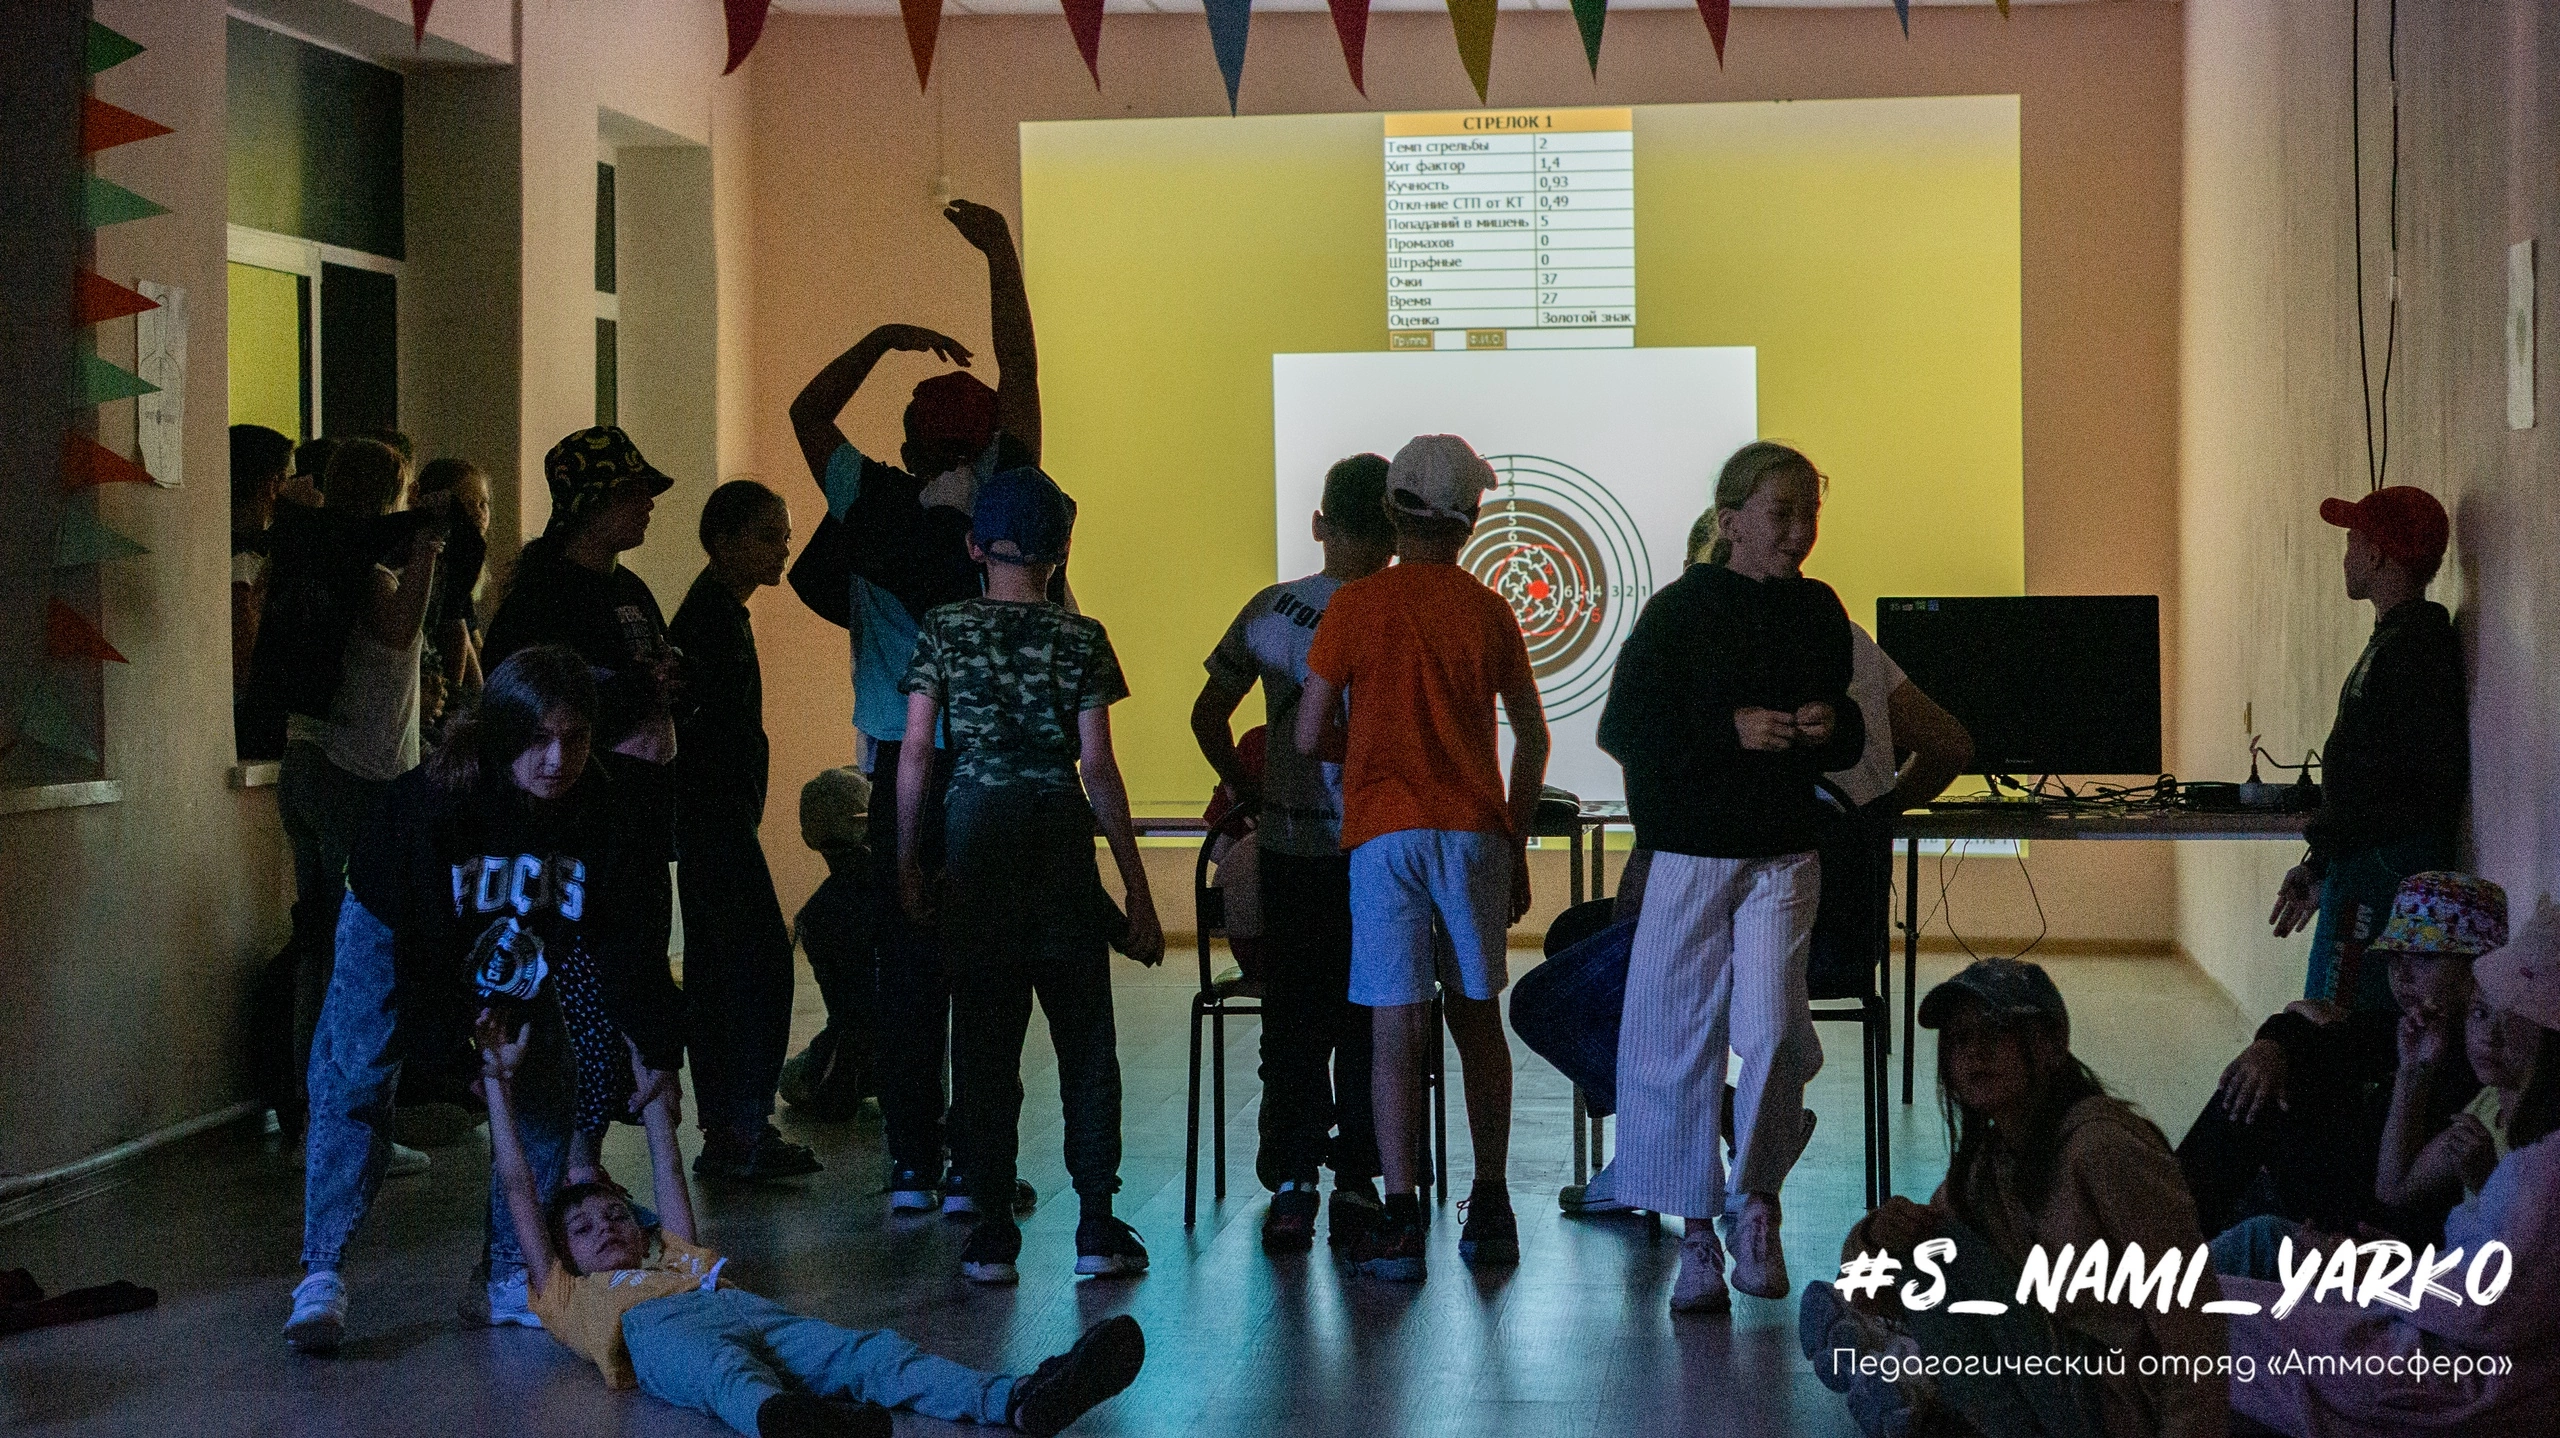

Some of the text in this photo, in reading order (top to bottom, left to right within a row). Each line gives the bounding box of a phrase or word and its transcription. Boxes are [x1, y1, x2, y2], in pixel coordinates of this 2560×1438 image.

[1463, 115, 1553, 130] СТРЕЛОК 1
[1388, 140, 1489, 155] Темп стрельбы
[1540, 138, 1547, 149] 2
[1387, 160, 1465, 175] Хит фактор
[1540, 157, 1560, 171] 1,4
[1388, 180, 1449, 195] Кучность
[1540, 176, 1569, 190] 0,93
[1388, 196, 1524, 211] Откл-ние СТП от КТ
[1540, 196, 1569, 211] 0,49
[1388, 216, 1529, 231] Попаданий в мишень
[1541, 215, 1549, 227] 5
[1389, 237, 1454, 251] Промахов
[1541, 234, 1549, 246] 0
[1389, 255, 1462, 271] Штрафные
[1541, 254, 1549, 266] 0
[1390, 276, 1422, 288] Очки
[1541, 273, 1558, 285] 37
[1390, 295, 1431, 309] Время
[1542, 292, 1558, 305] 27
[1390, 315, 1439, 328] Оценка
[1542, 310, 1632, 324] Золотой знак
[1564, 585, 1573, 598] 6
[1612, 585, 1620, 597] 3
[1626, 585, 1634, 597] 2
[1641, 586, 1647, 597] 1
